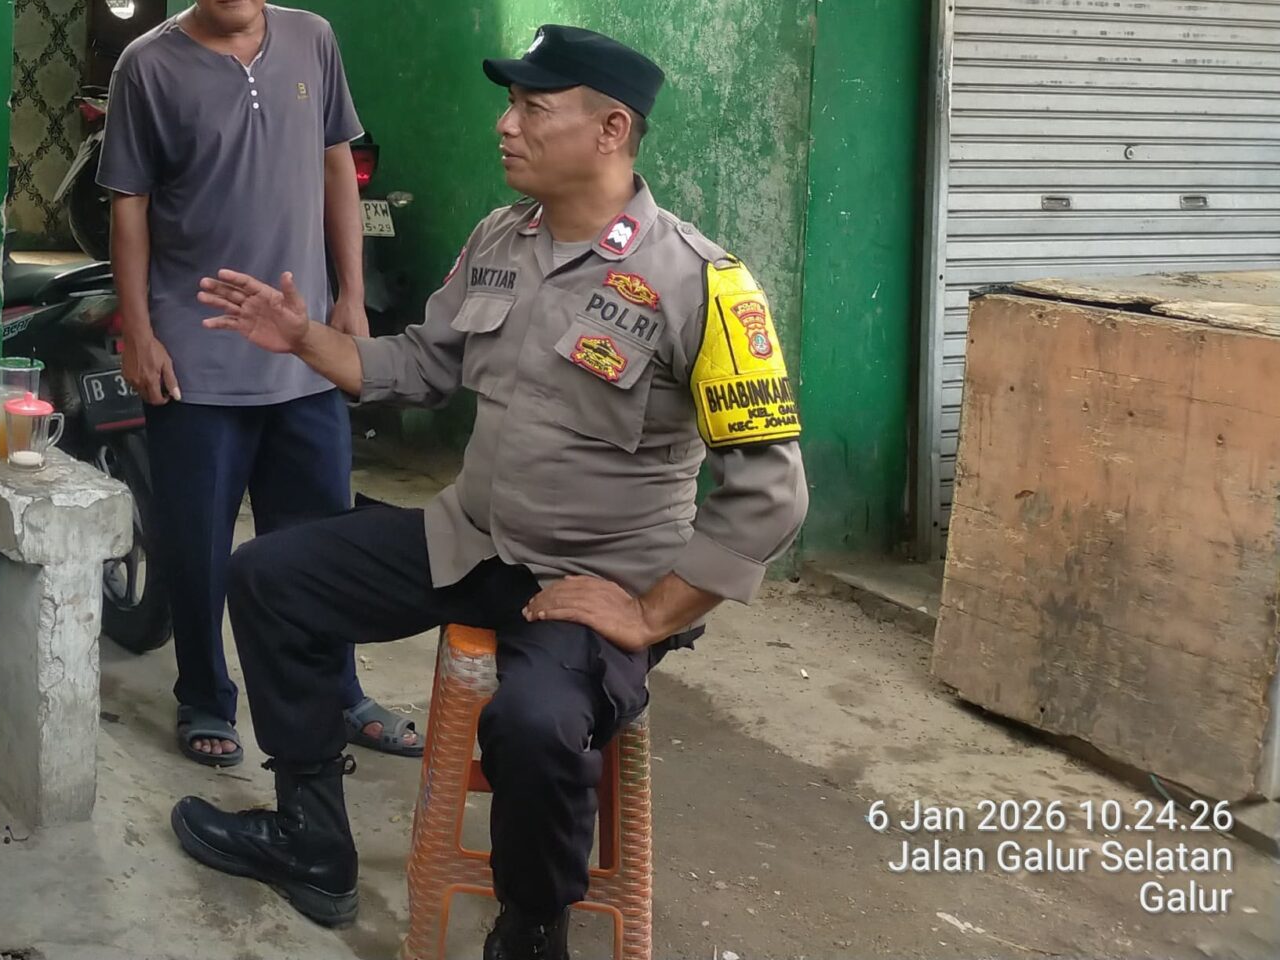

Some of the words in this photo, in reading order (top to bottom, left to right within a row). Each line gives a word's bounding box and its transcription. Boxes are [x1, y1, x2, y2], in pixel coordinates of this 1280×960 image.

[585, 293, 659, 342] POLRI
[91, 378, 105, 401] B
[748, 407, 774, 419] KEL.
[728, 420, 758, 433] KEC.
